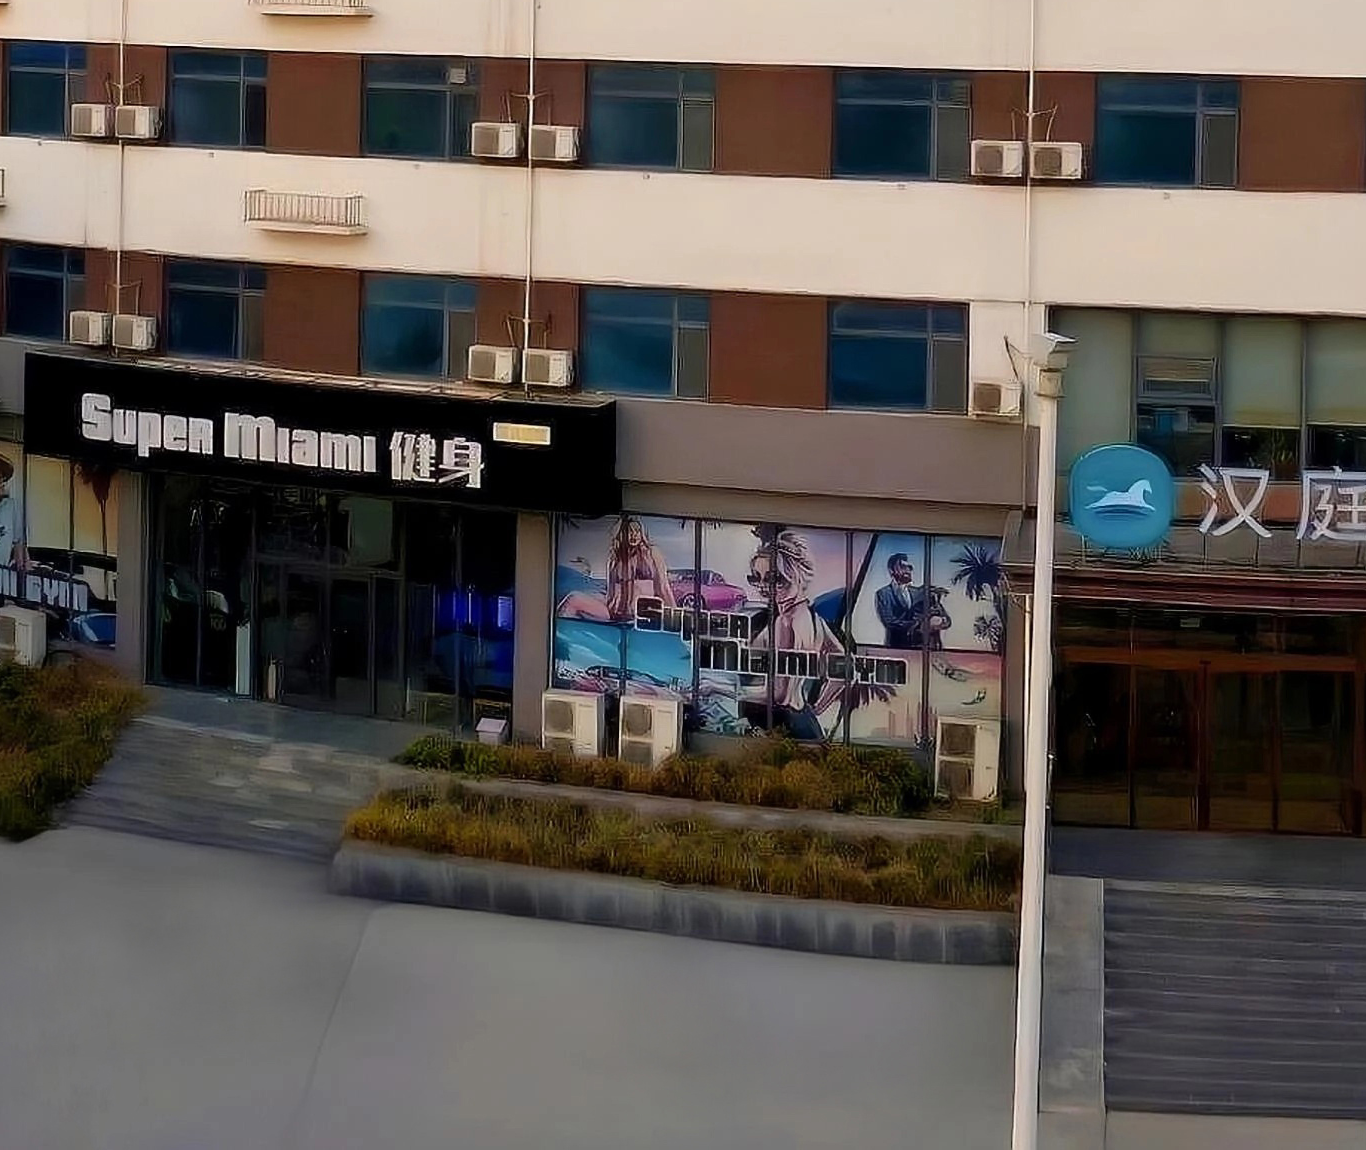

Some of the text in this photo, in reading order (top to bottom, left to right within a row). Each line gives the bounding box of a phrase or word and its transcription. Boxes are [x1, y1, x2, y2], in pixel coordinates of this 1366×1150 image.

[81, 392, 485, 488] Super Miami 健身
